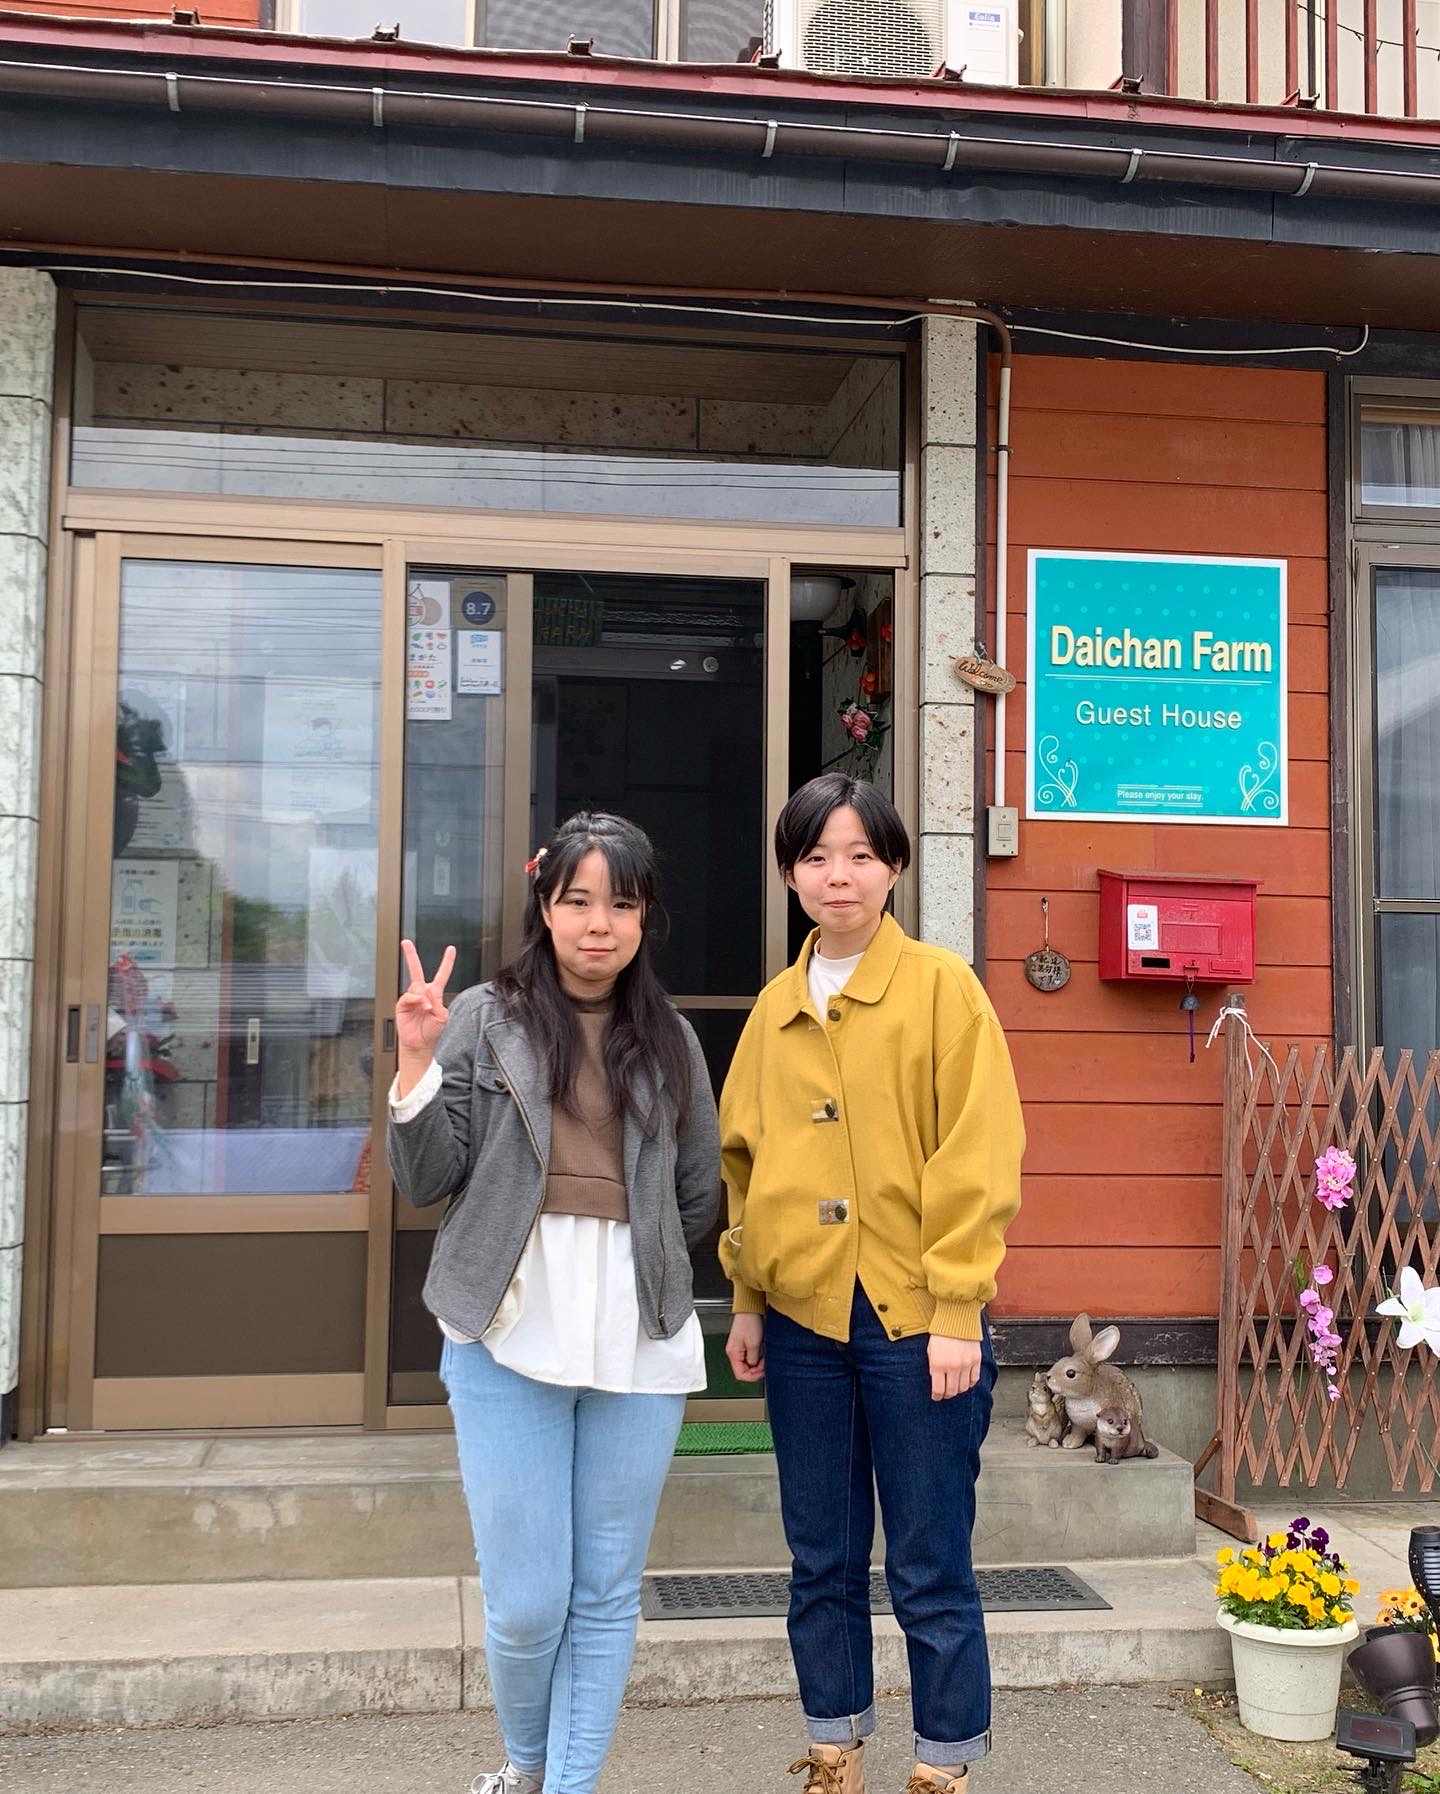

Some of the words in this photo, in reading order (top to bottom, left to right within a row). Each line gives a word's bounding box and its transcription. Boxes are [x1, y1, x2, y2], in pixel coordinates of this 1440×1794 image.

[465, 602, 492, 615] 8.7
[1051, 625, 1182, 669] Daichan
[1192, 630, 1272, 672] Farm
[958, 659, 1004, 683] Welcome
[1076, 701, 1151, 726] Guest
[1162, 703, 1242, 729] House
[1117, 790, 1144, 799] Please
[1145, 792, 1167, 800] enjoy
[1167, 792, 1185, 801] your
